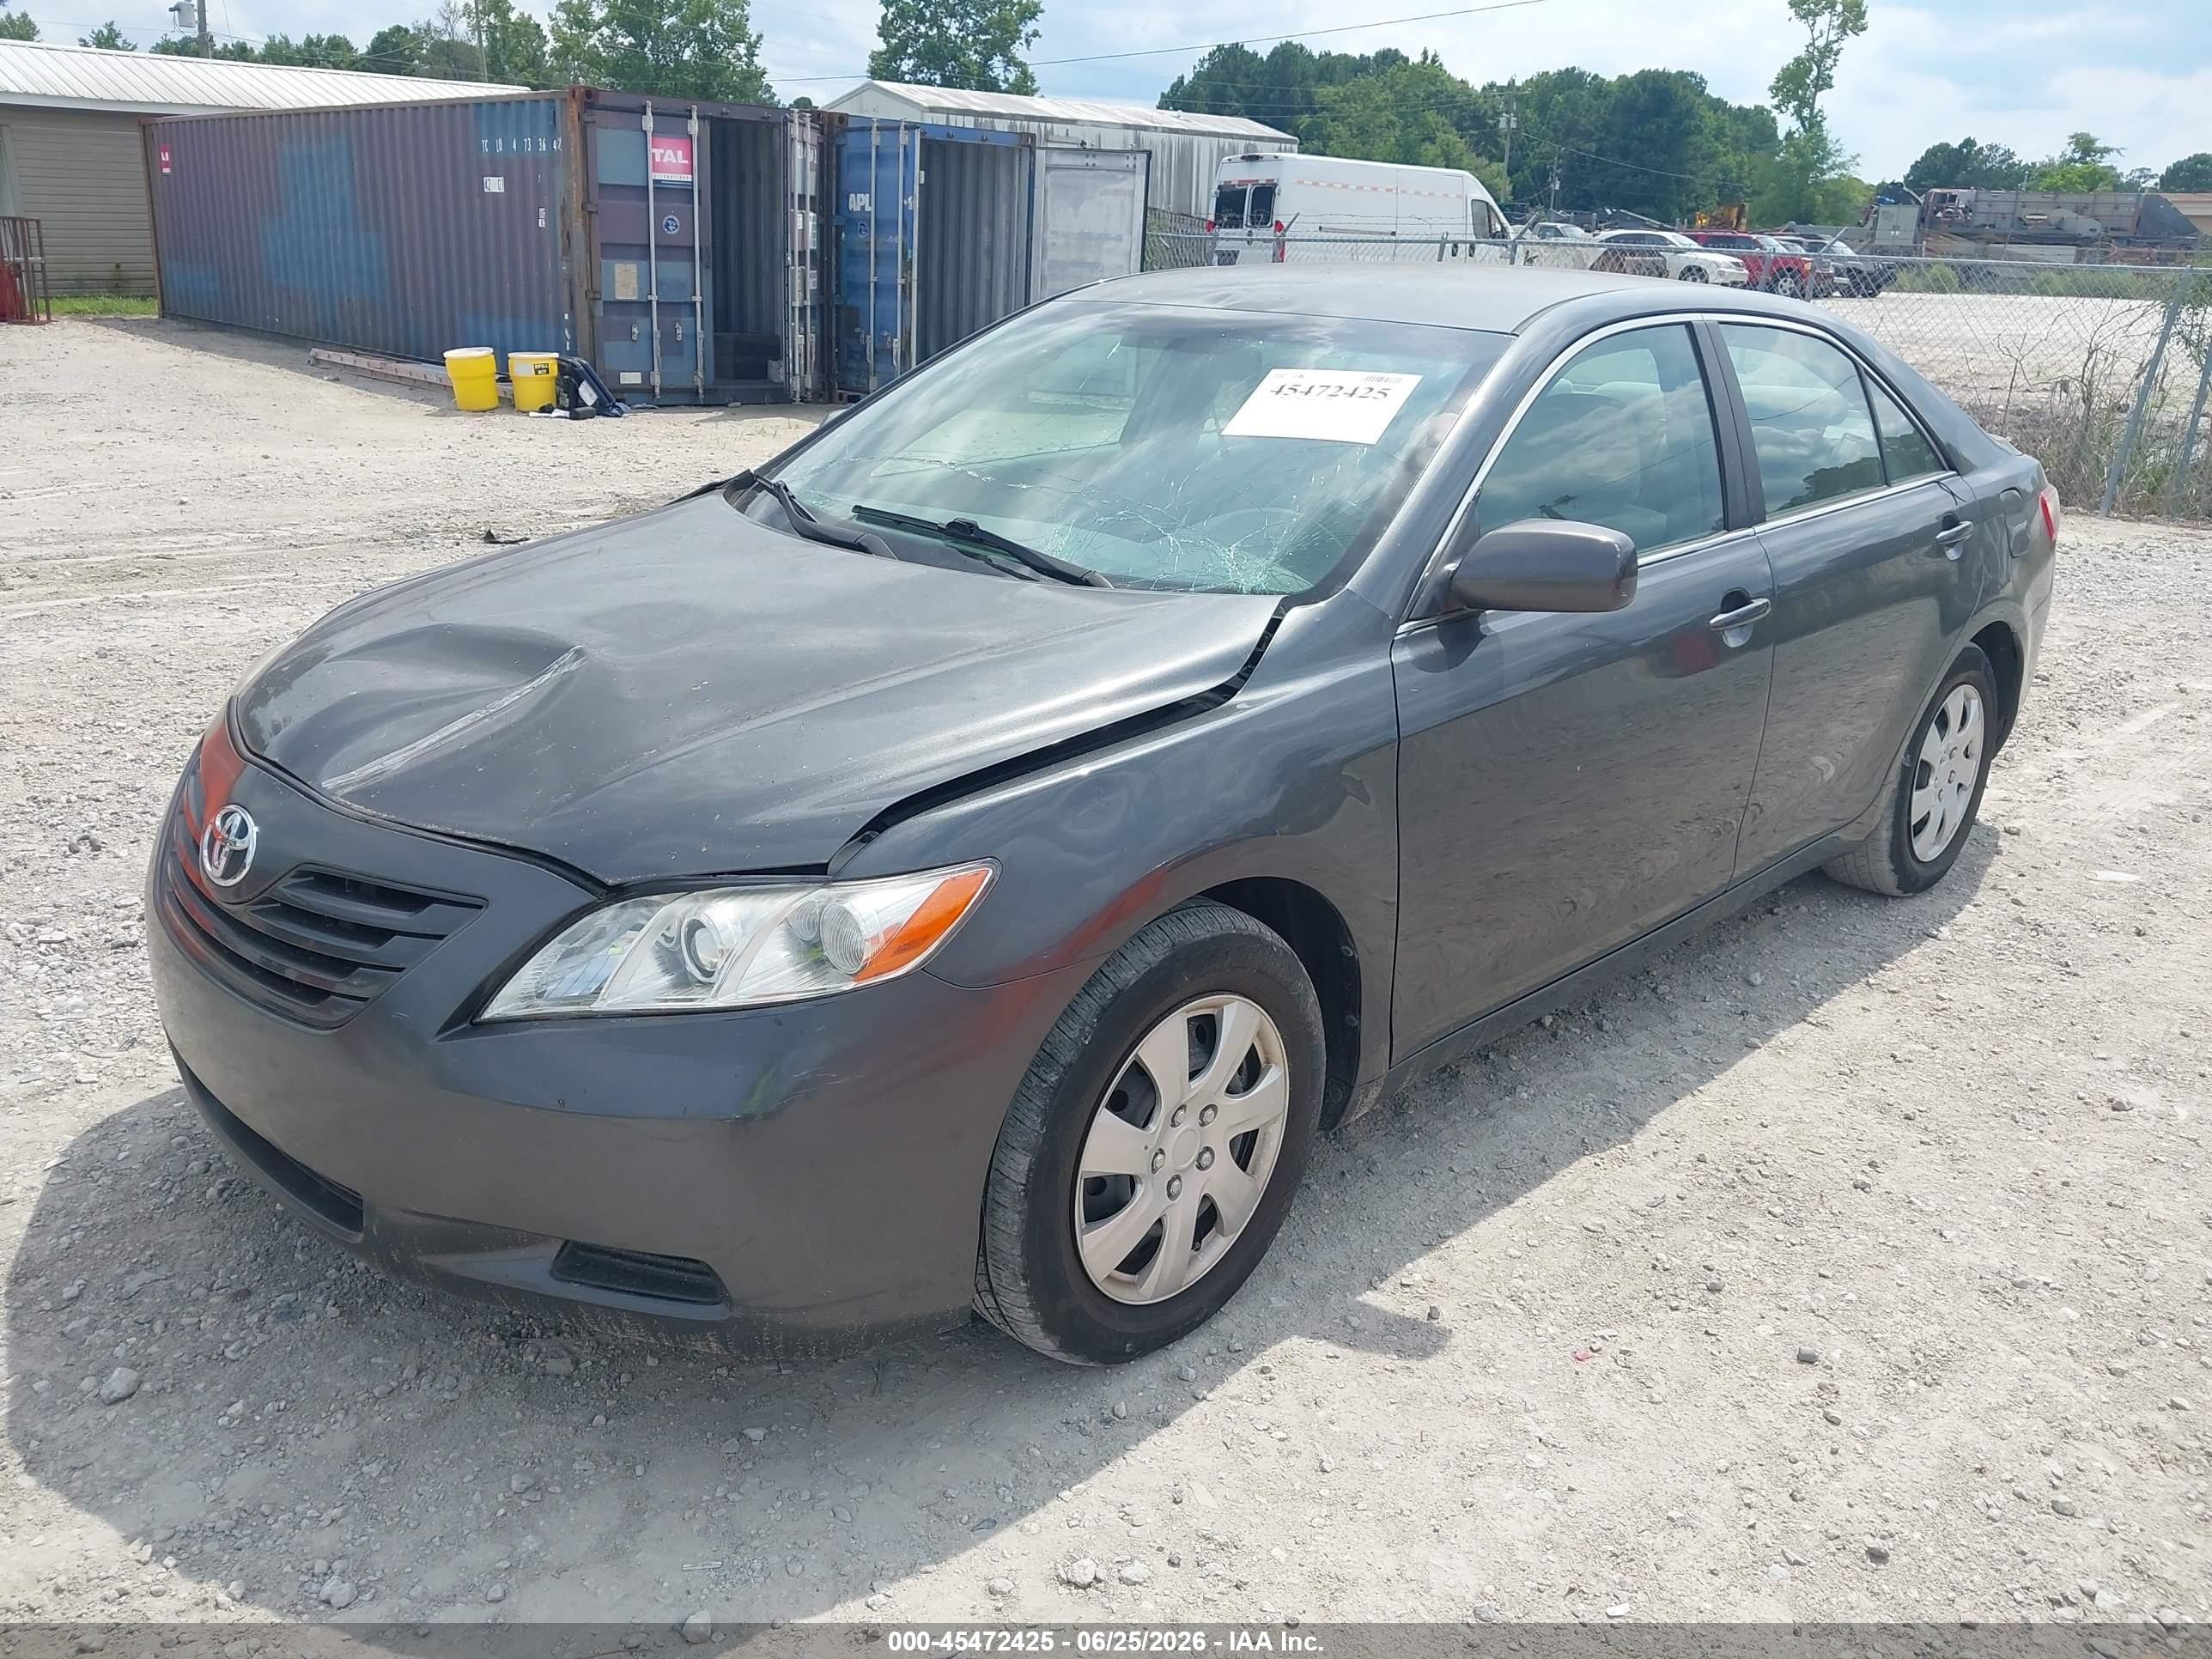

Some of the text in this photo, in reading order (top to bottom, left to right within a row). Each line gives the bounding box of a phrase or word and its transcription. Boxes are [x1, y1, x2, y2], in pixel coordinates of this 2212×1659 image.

[651, 148, 689, 164] TAL
[848, 193, 872, 212] APL
[1271, 384, 1392, 400] 45472425
